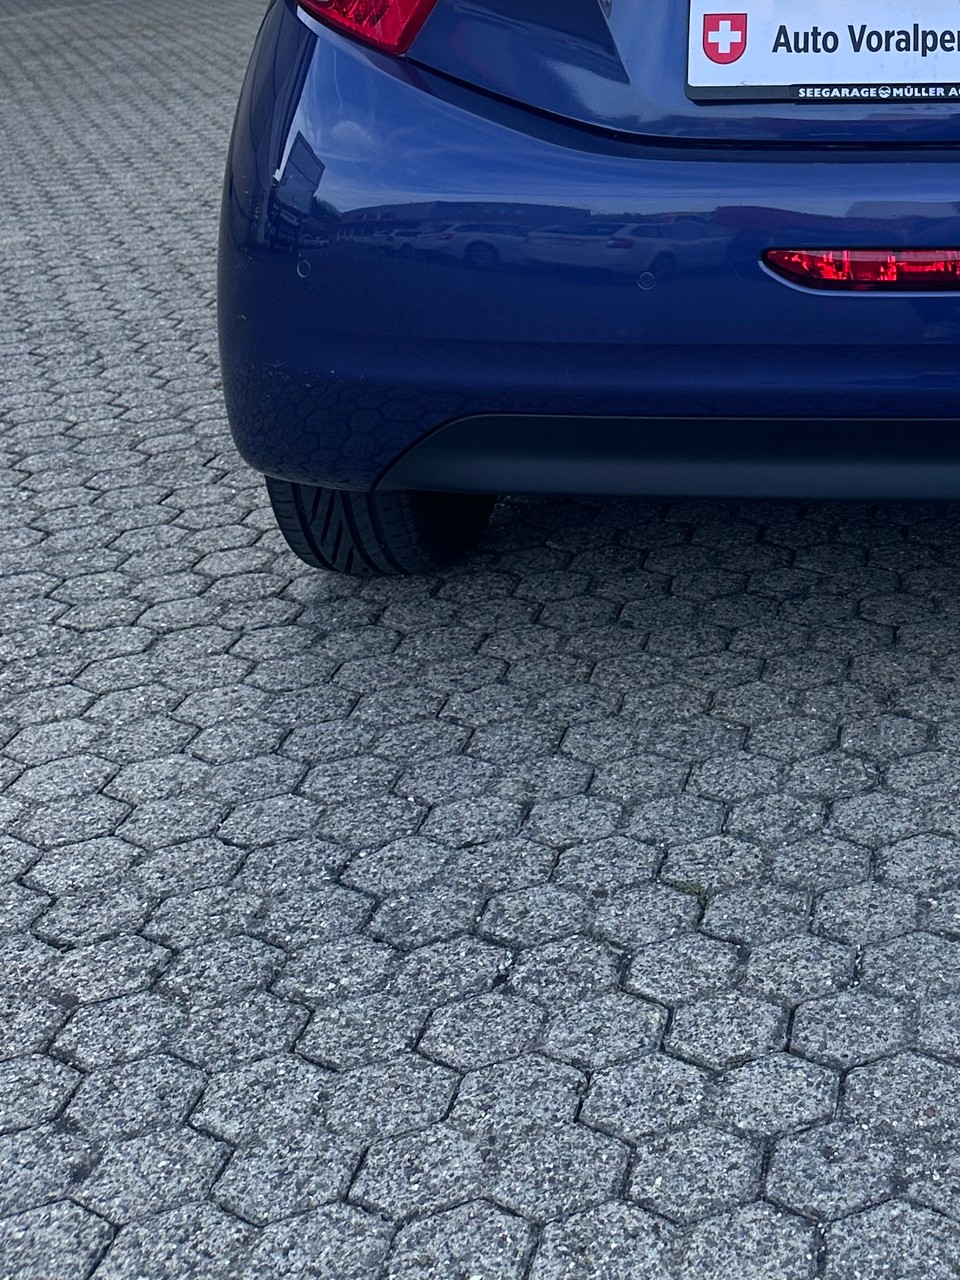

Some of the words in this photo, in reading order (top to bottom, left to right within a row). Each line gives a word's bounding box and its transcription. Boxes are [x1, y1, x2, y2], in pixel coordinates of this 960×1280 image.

[771, 24, 839, 54] Auto
[798, 87, 877, 98] SEEGARAGE
[892, 85, 945, 97] MÜLLER
